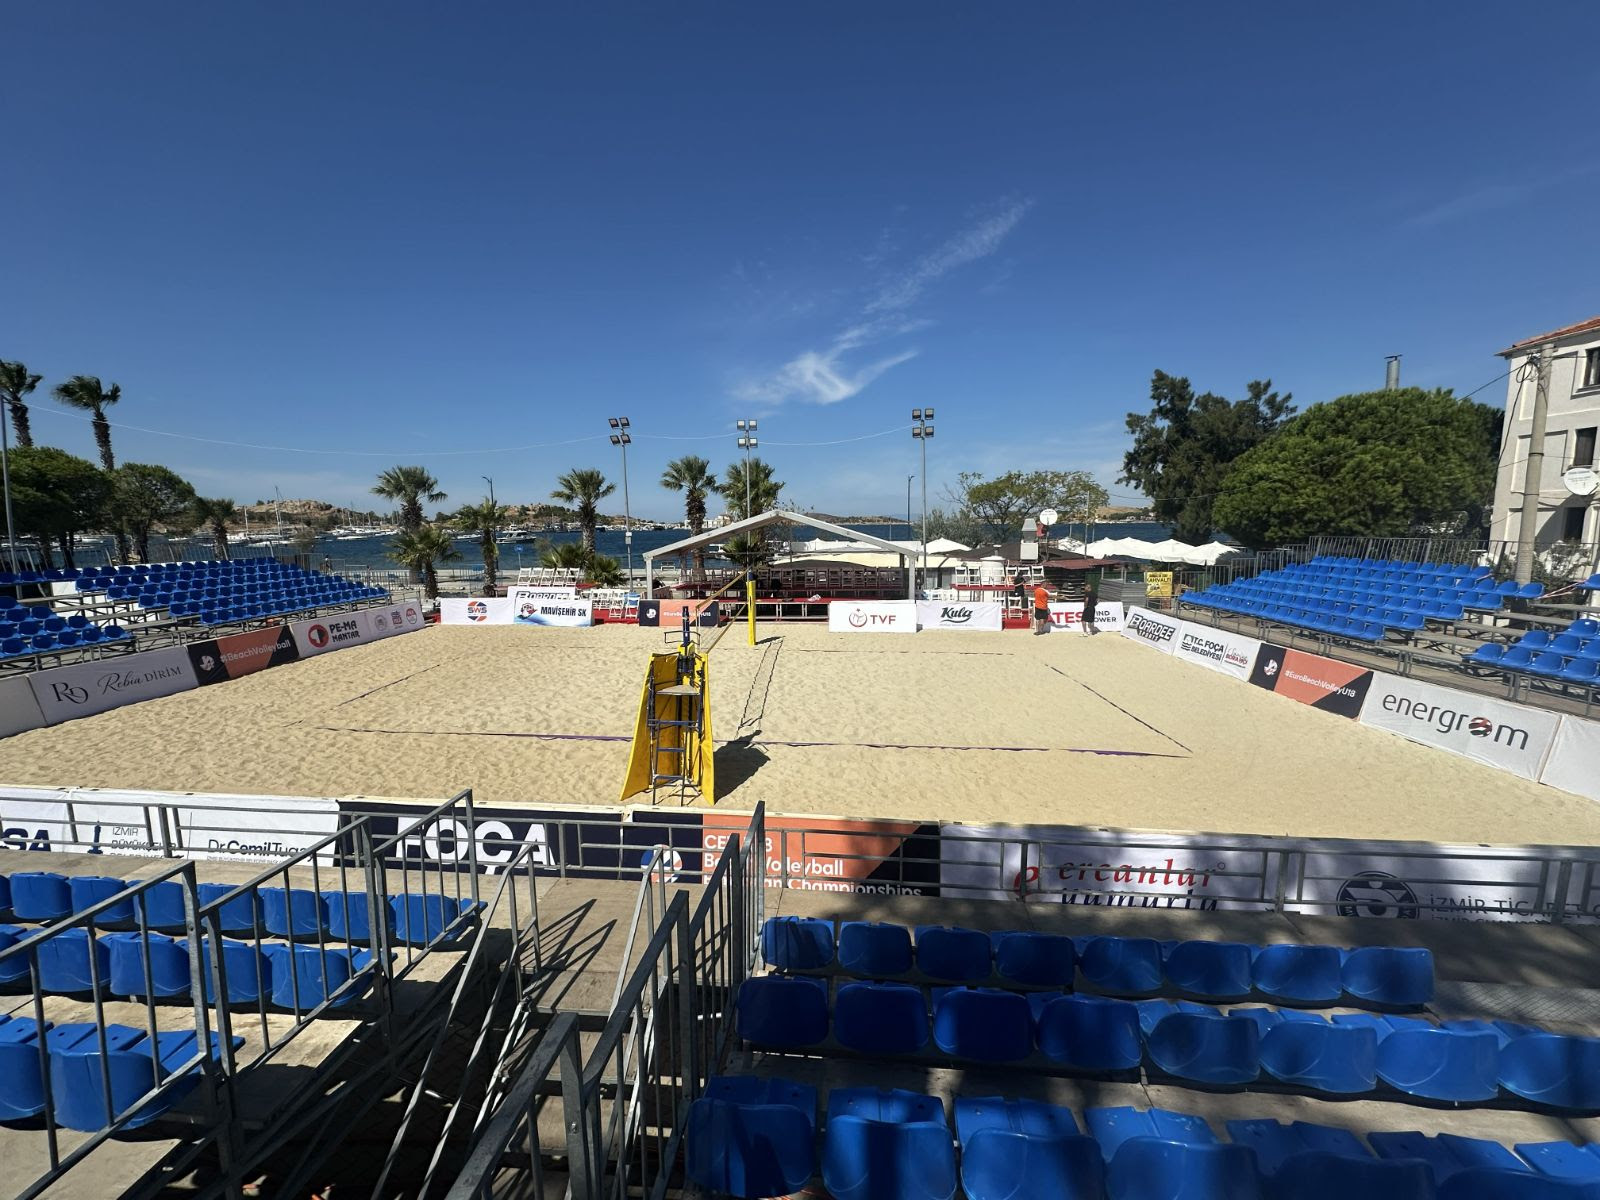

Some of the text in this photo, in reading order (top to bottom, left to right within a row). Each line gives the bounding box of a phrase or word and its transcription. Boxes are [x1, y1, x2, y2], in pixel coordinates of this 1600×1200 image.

[467, 606, 487, 614] SWS
[540, 605, 576, 617] MAVİŞEHİR
[577, 608, 587, 617] SK
[940, 606, 973, 619] Kula
[870, 614, 896, 625] TVF
[1127, 613, 1176, 641] BOARDEE
[329, 620, 357, 635] PE-MA
[332, 630, 361, 643] MANTAR
[221, 640, 291, 663] #BeachVolleyball
[1190, 645, 1223, 662] BELEDİYESİ
[1204, 640, 1225, 653] FOÇA
[97, 665, 183, 696] Rebia DİRİM
[1285, 670, 1356, 698] #EuroBeachVolleyU18
[1430, 894, 1488, 914] İZMİR
